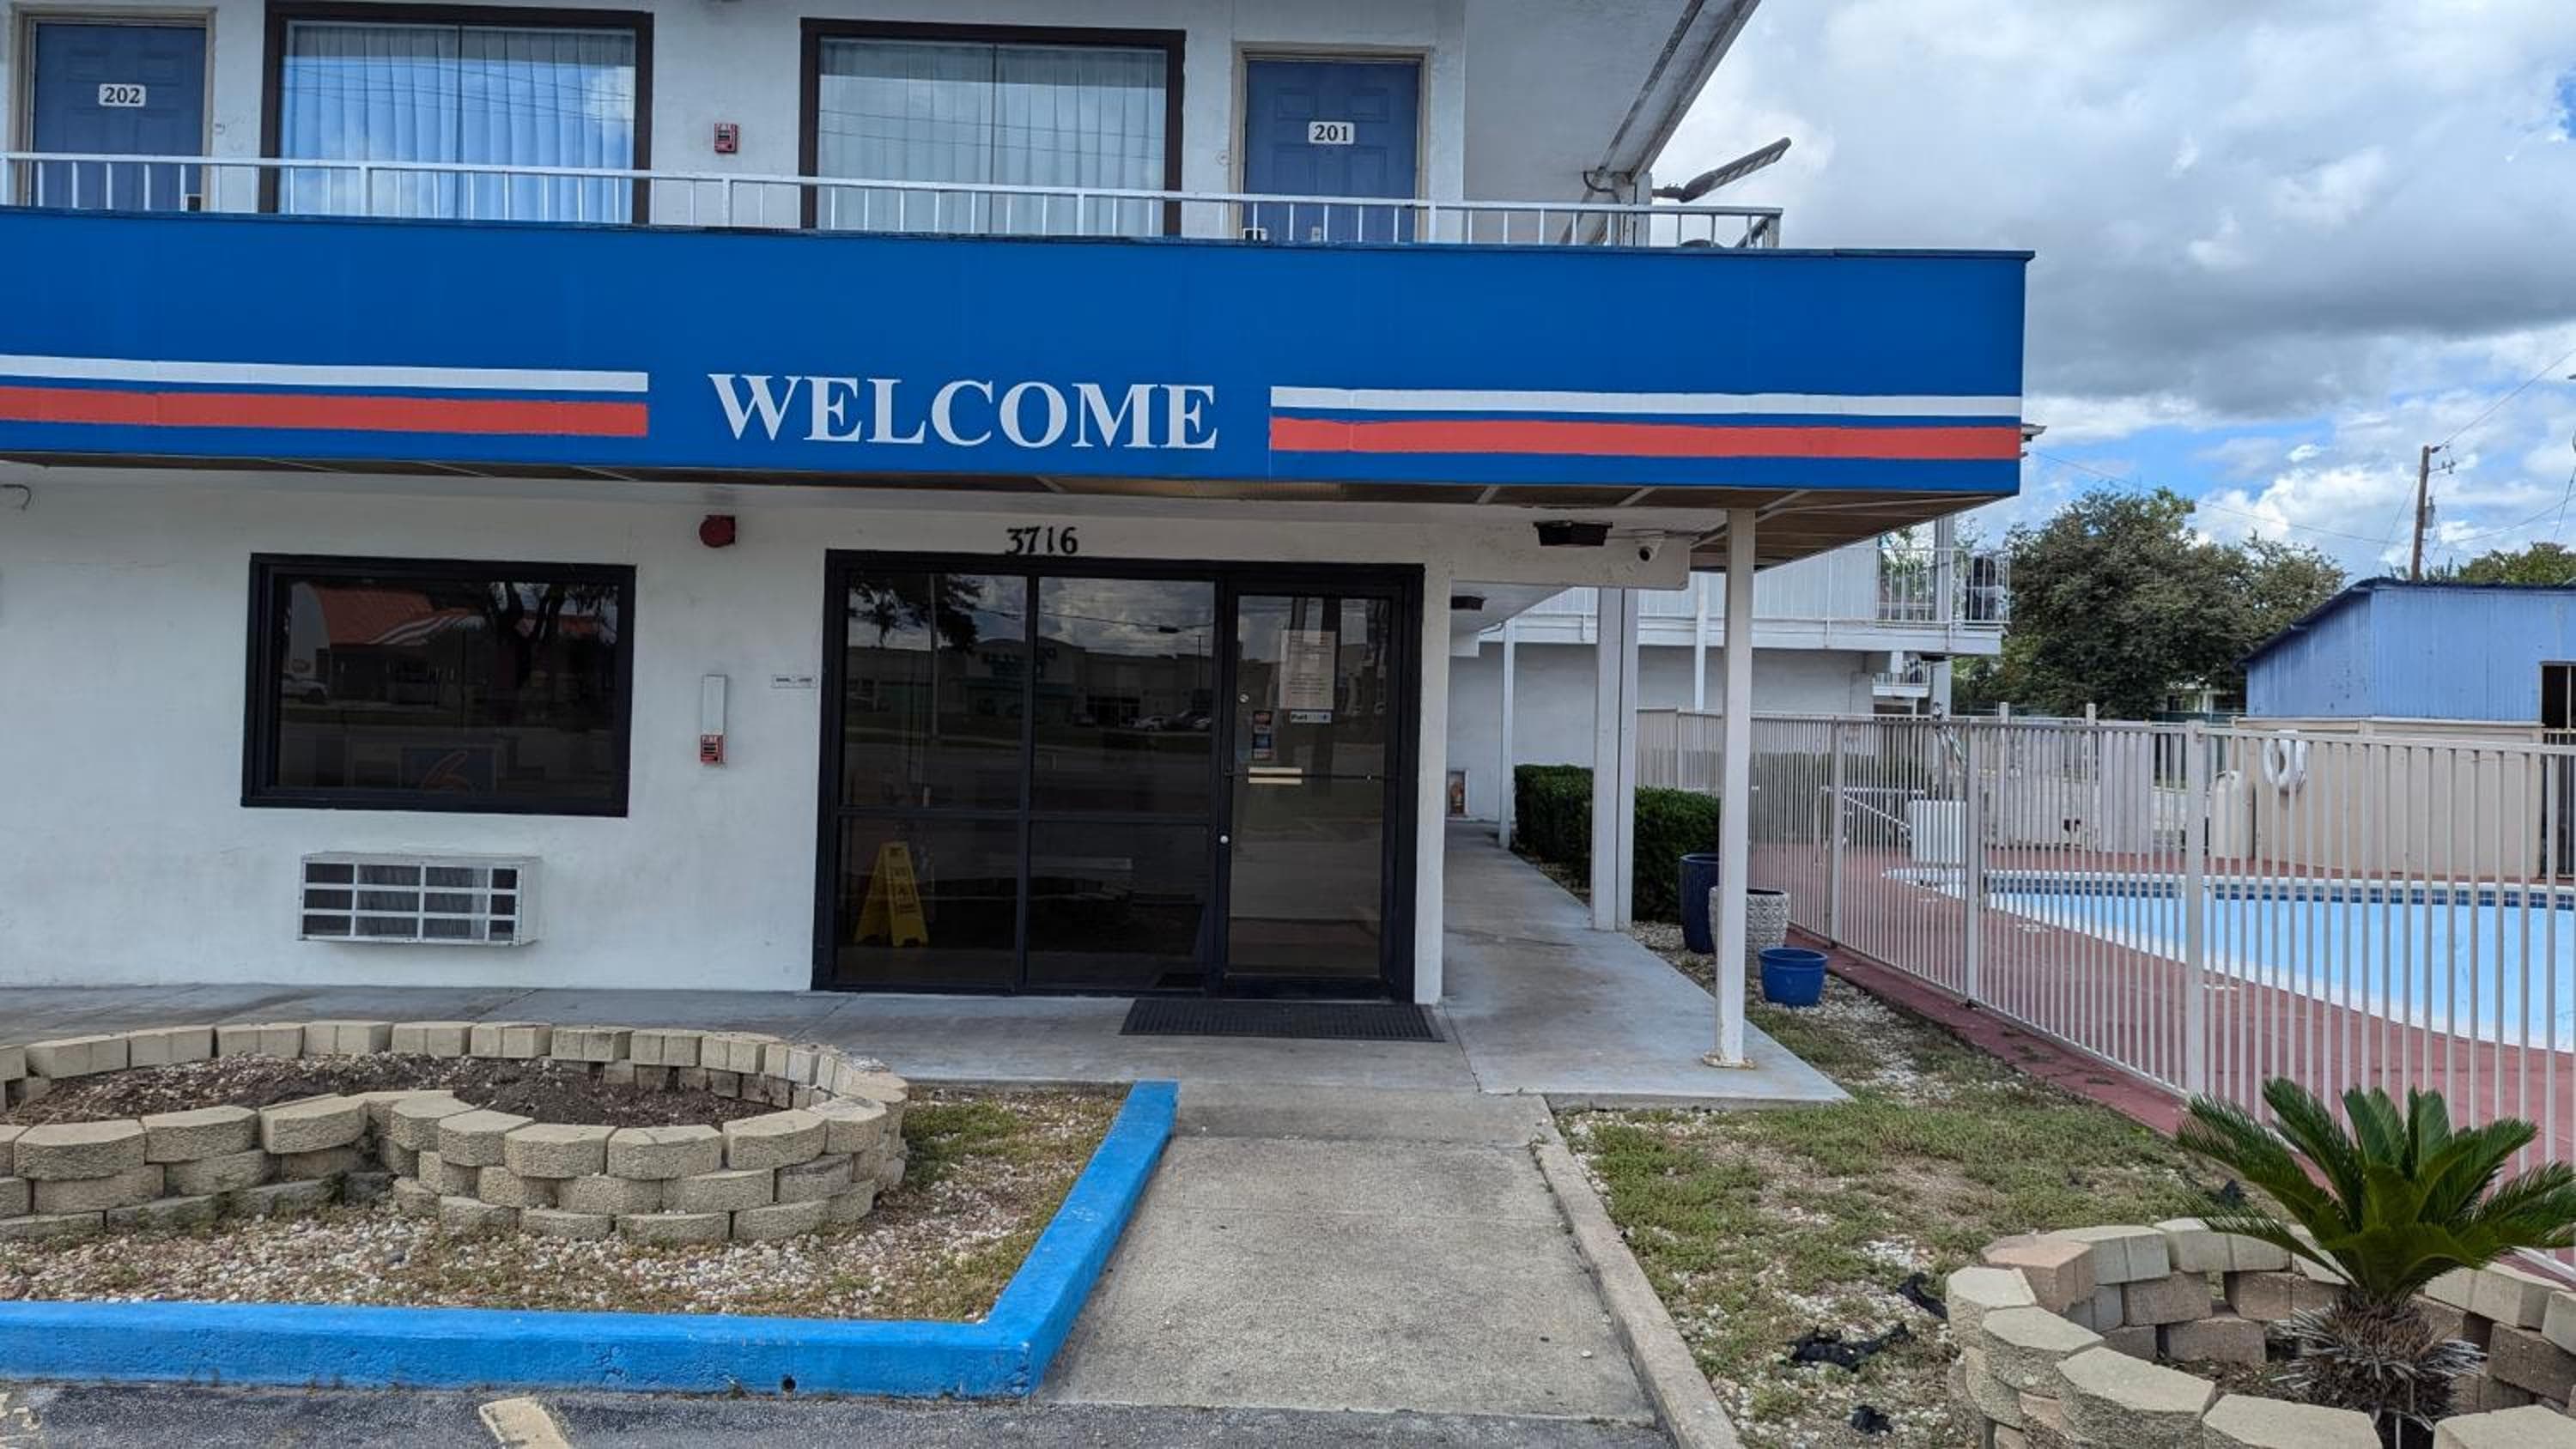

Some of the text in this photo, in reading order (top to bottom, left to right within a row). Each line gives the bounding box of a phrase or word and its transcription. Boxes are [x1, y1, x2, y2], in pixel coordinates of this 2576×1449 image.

[103, 87, 140, 104] 202
[1314, 124, 1348, 142] 201
[708, 373, 1218, 449] WELCOME
[1005, 525, 1078, 555] 3716
